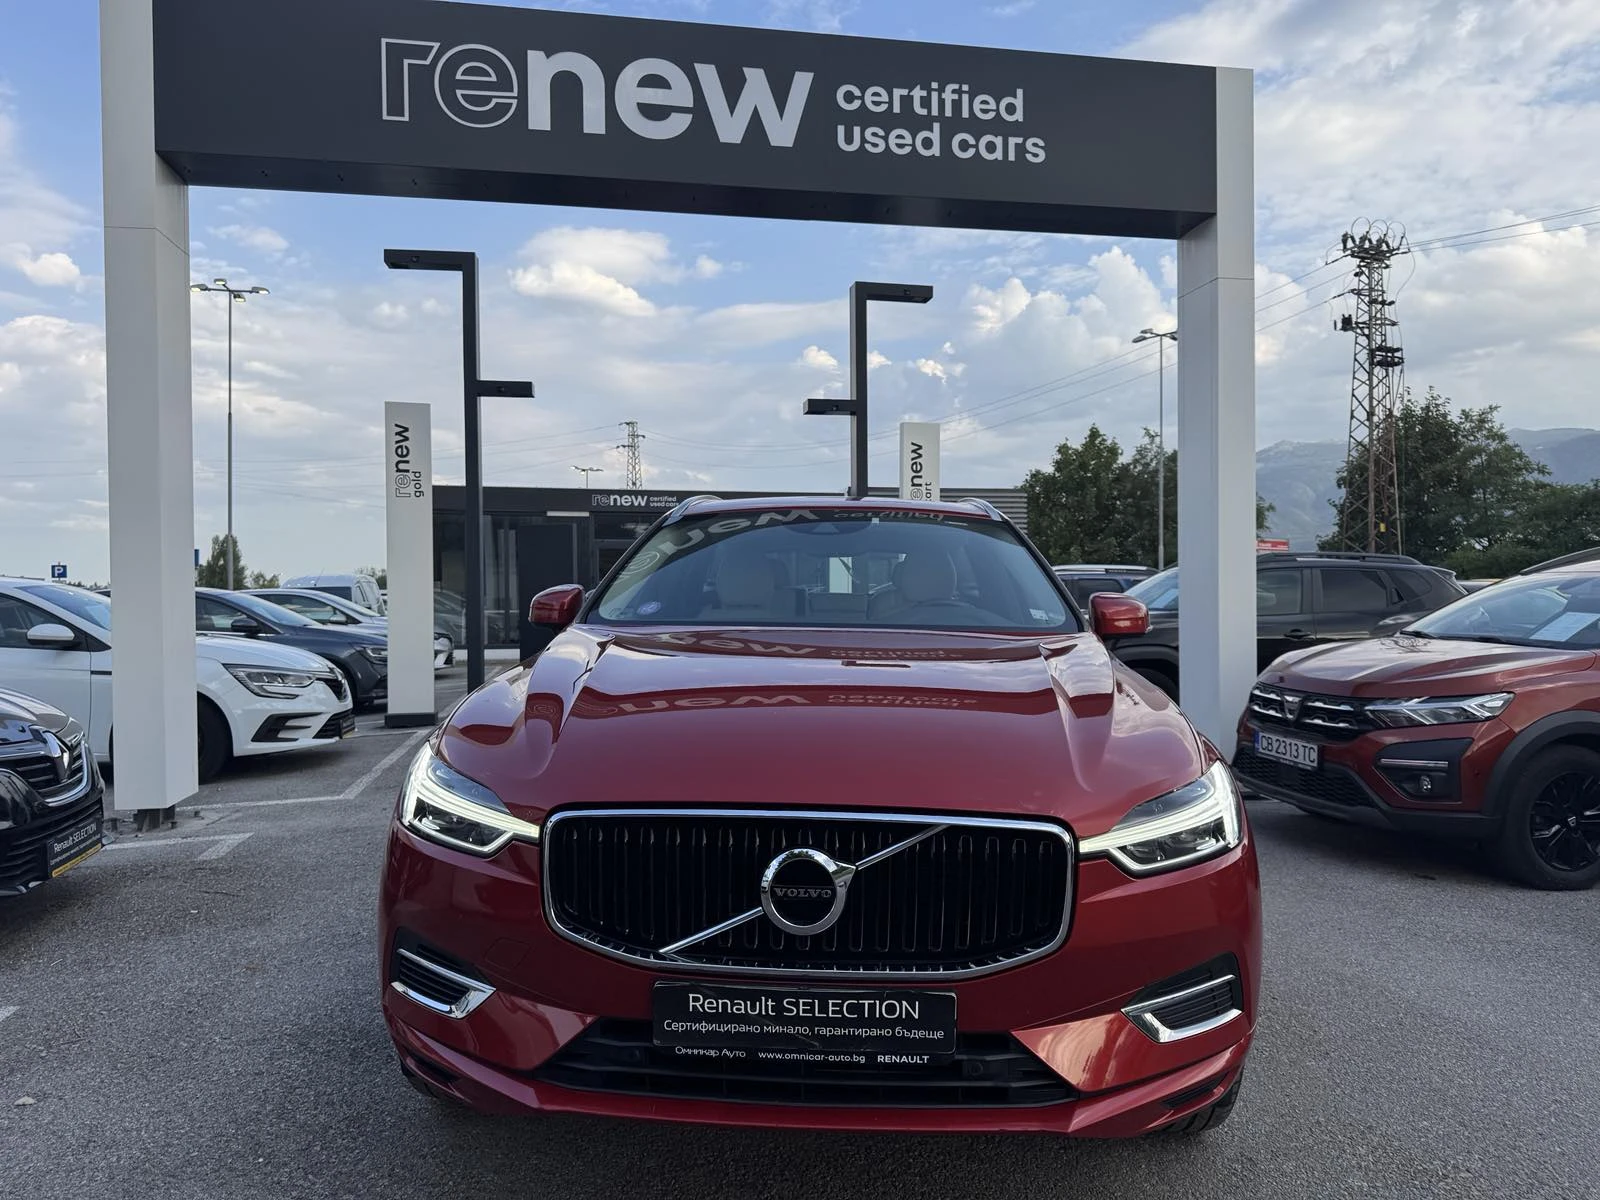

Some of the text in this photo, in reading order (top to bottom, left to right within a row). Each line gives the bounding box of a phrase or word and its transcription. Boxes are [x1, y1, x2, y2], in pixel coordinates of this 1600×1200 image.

[380, 37, 815, 148] renew
[835, 81, 1024, 122] certified
[836, 122, 1046, 164] used cars
[394, 423, 412, 498] renew
[910, 441, 924, 500] enew
[411, 471, 425, 498] gold
[591, 494, 648, 507] renew
[54, 566, 64, 577] P
[1275, 739, 1299, 759] 2313
[1301, 744, 1316, 763] TC
[773, 887, 832, 898] VOLVO
[688, 993, 919, 1020] Renault SELECTION
[663, 1019, 945, 1040] Сертифицирано минало, гарантирано бъдеще
[675, 1046, 746, 1059] Омникар Ауто
[758, 1051, 866, 1064] www.omnicar-auto.bg
[877, 1054, 930, 1064] RENAULT
